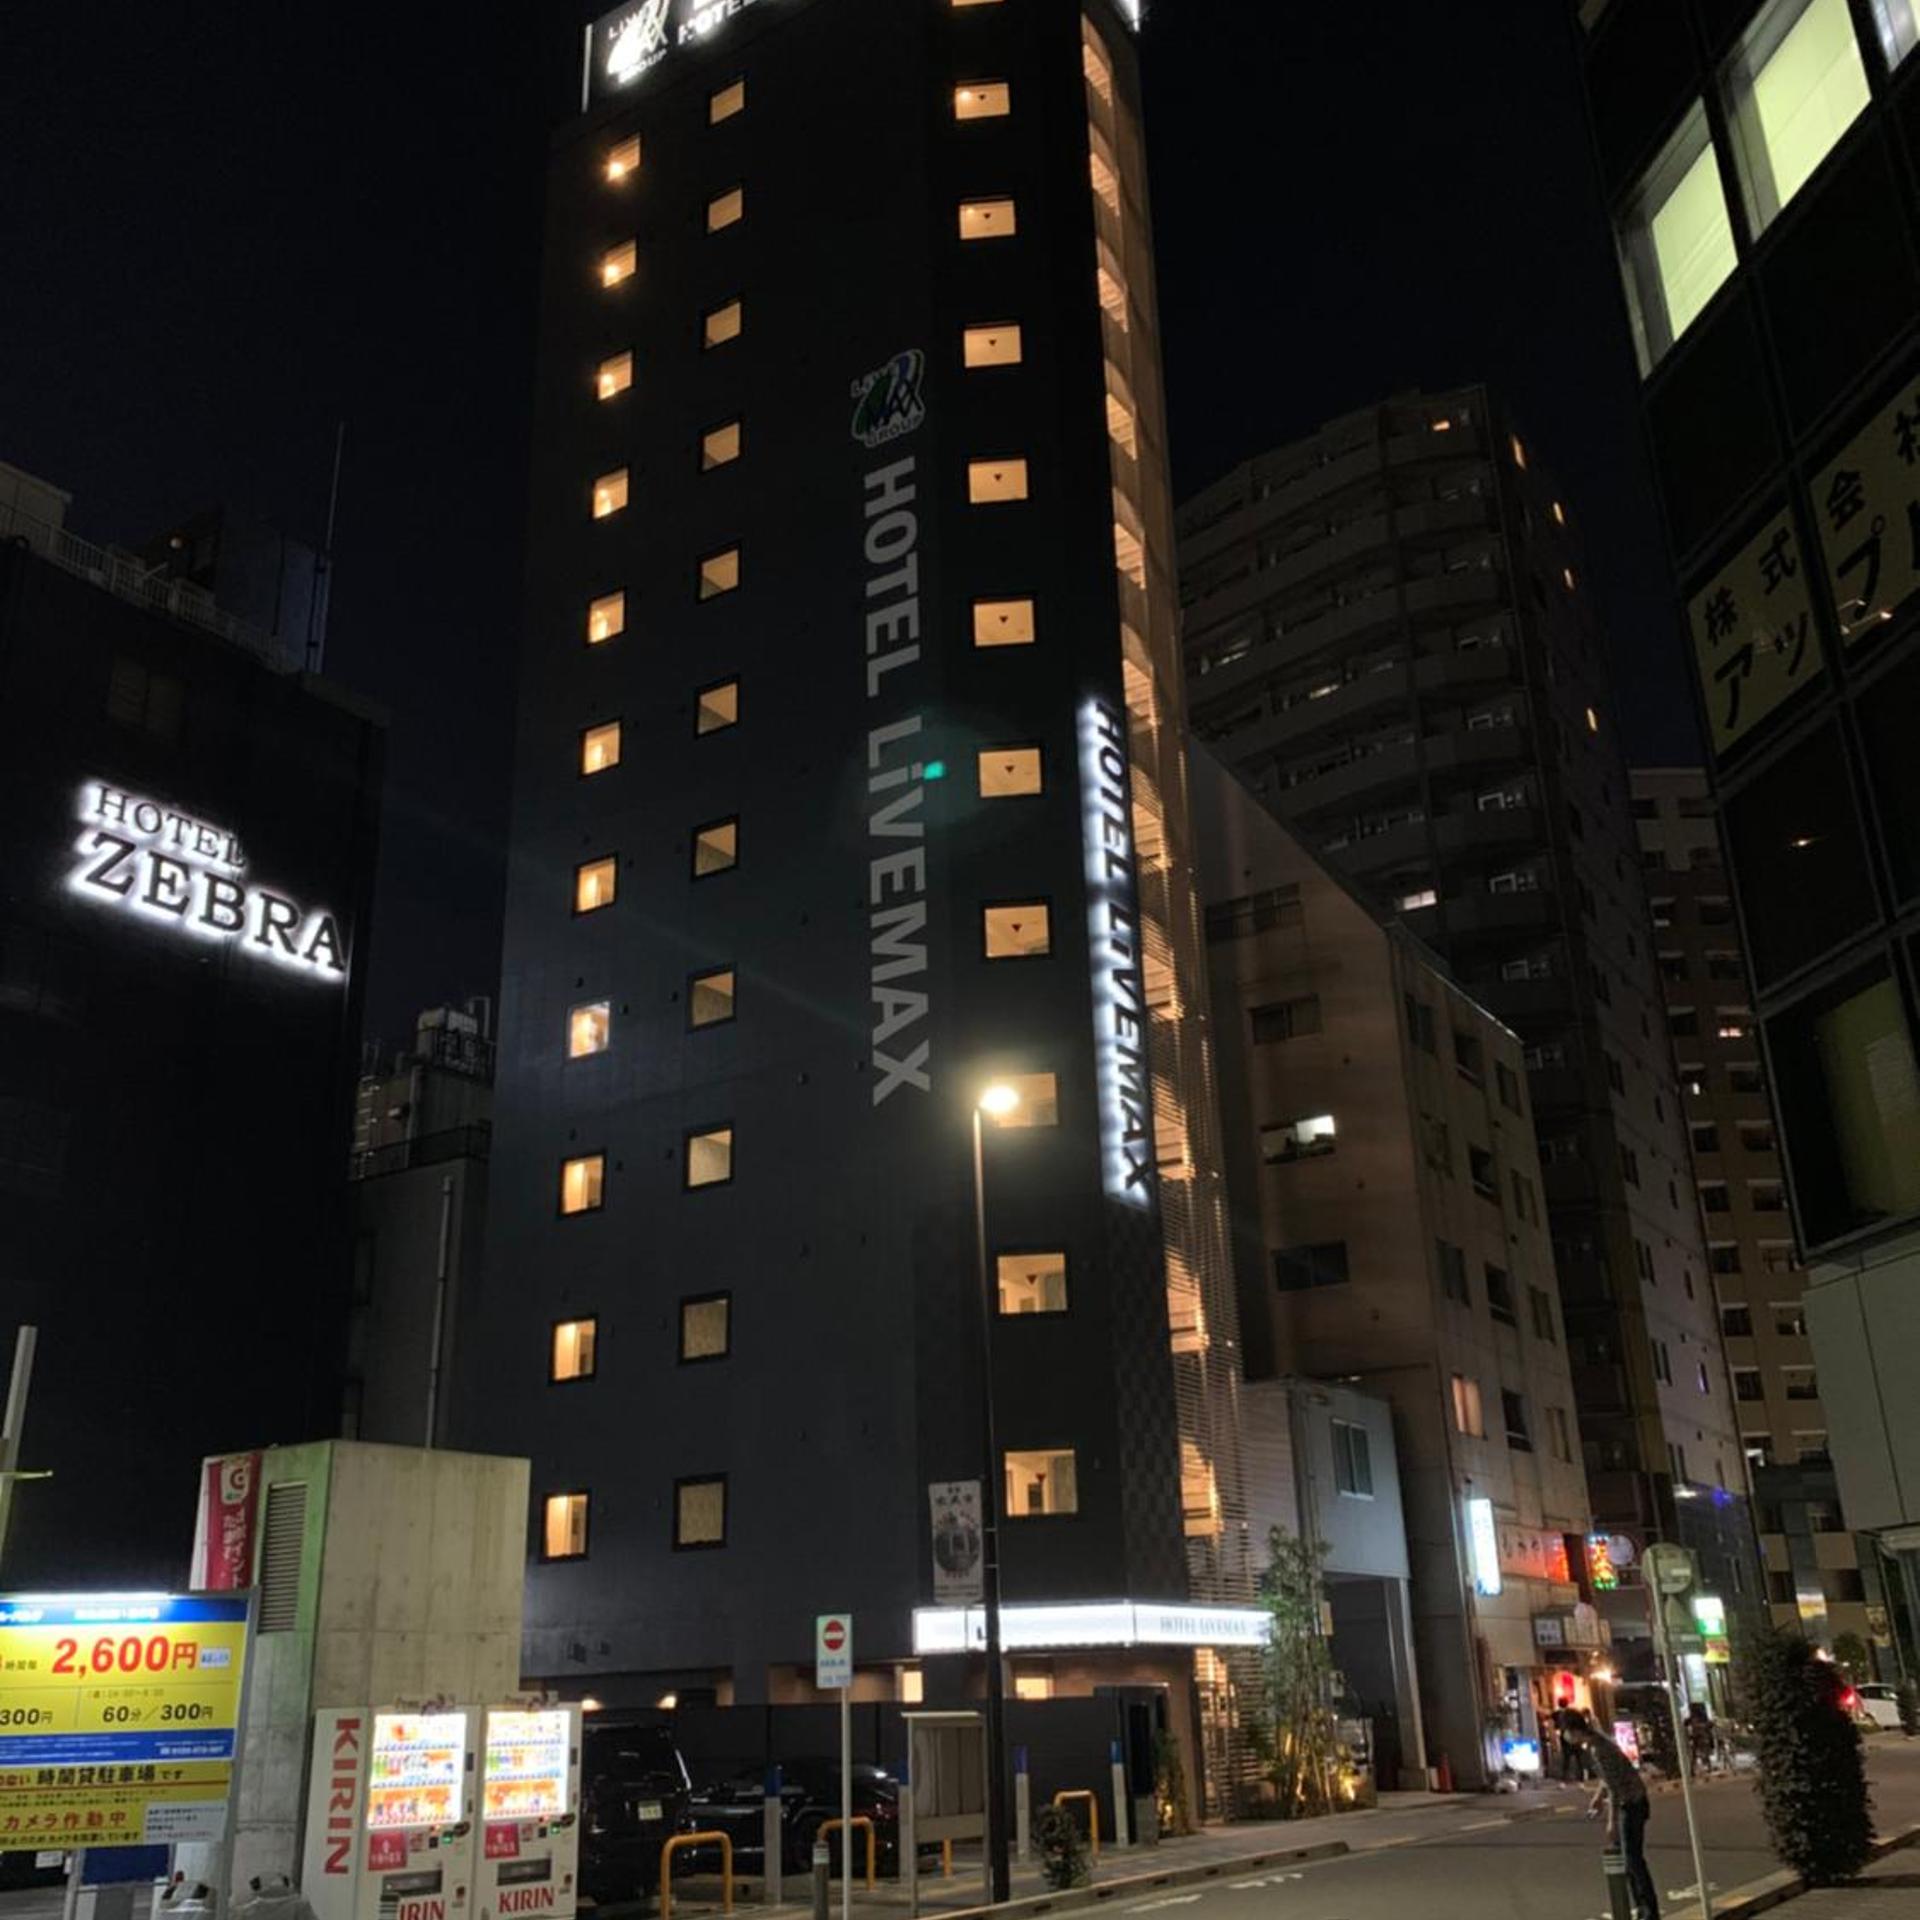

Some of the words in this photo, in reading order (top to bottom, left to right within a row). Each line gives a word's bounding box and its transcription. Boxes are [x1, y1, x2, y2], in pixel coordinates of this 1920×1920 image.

[864, 456, 920, 698] HOTEL
[94, 785, 246, 868] HOTEL
[1096, 699, 1132, 880] HOTEL
[85, 831, 345, 970] ZEBRA
[52, 1636, 198, 1679] 2,600円
[324, 1718, 361, 1874] KIRIN
[498, 1888, 554, 1914] KIRIN
